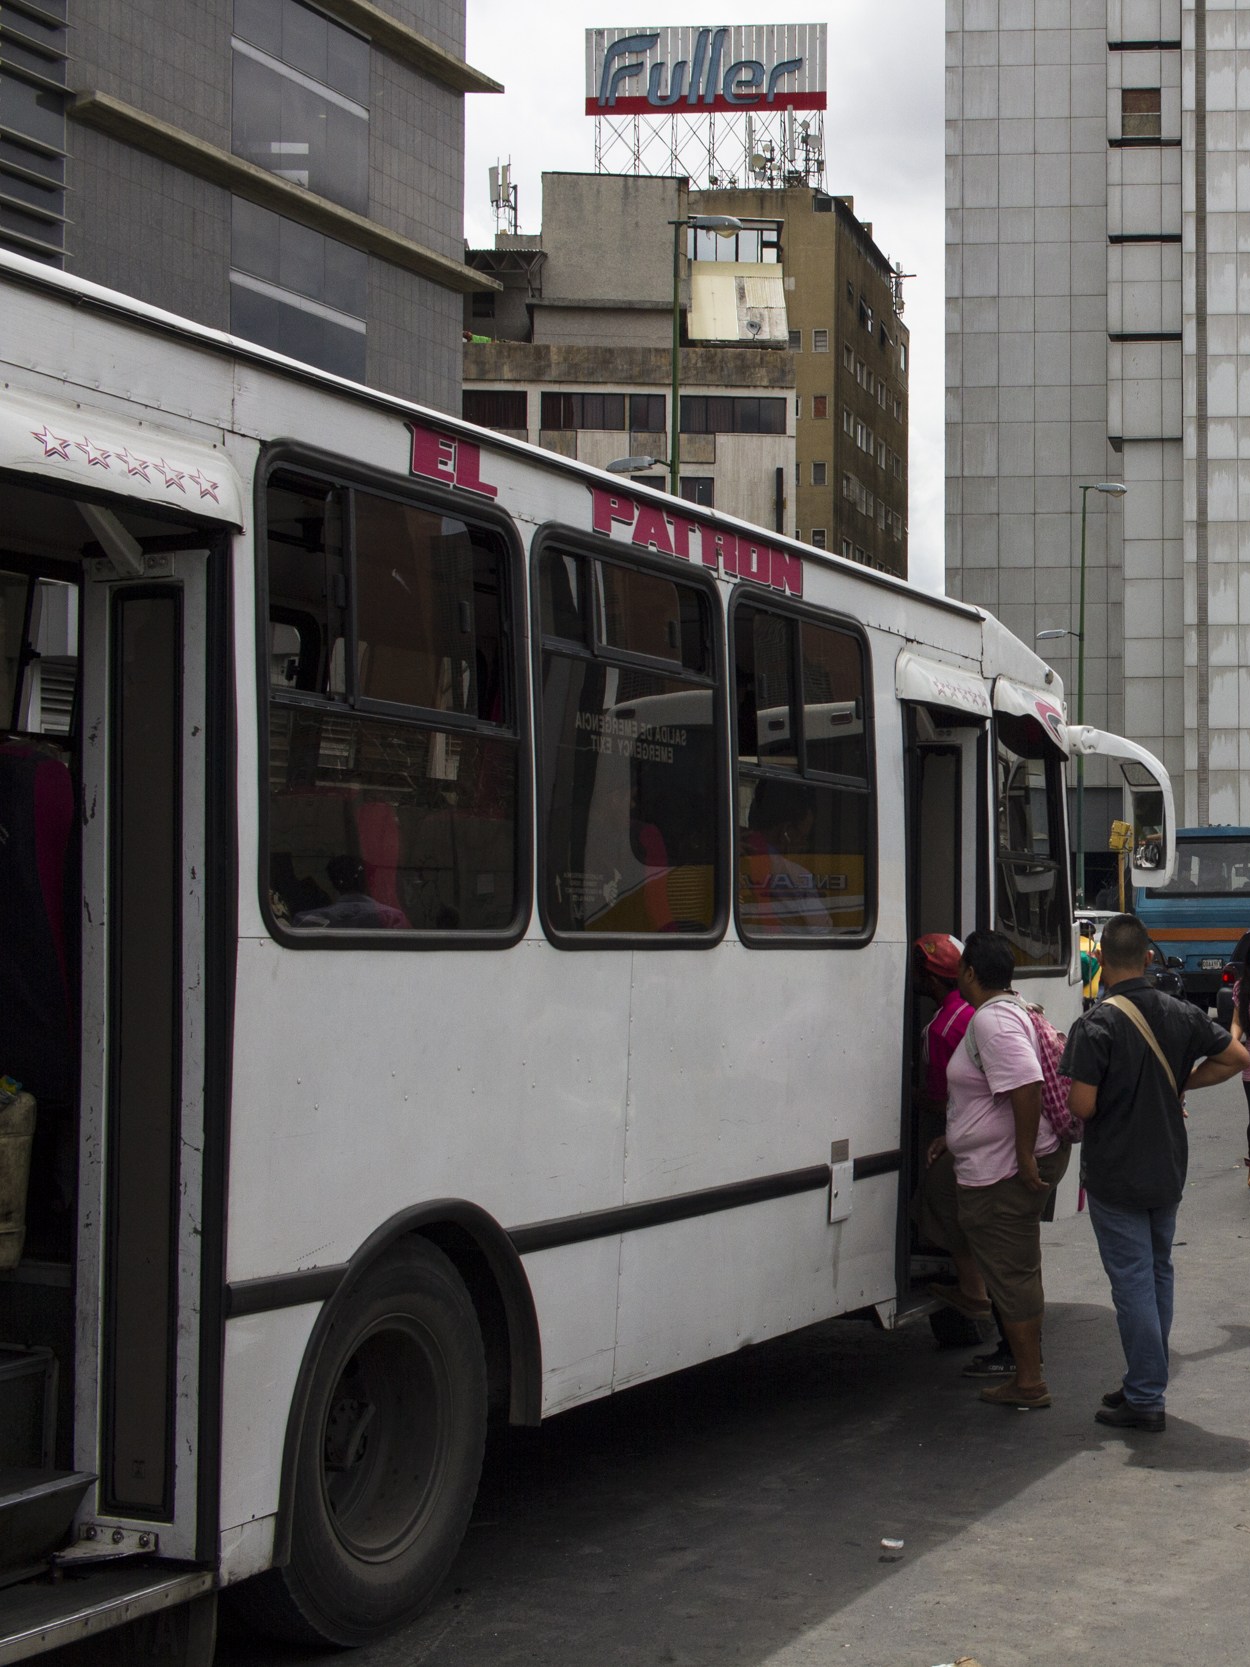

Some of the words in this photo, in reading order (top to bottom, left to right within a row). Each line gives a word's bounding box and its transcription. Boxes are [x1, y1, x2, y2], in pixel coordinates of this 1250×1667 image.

[598, 29, 803, 107] Fuller
[406, 422, 498, 501] EL
[588, 485, 803, 599] PATRON
